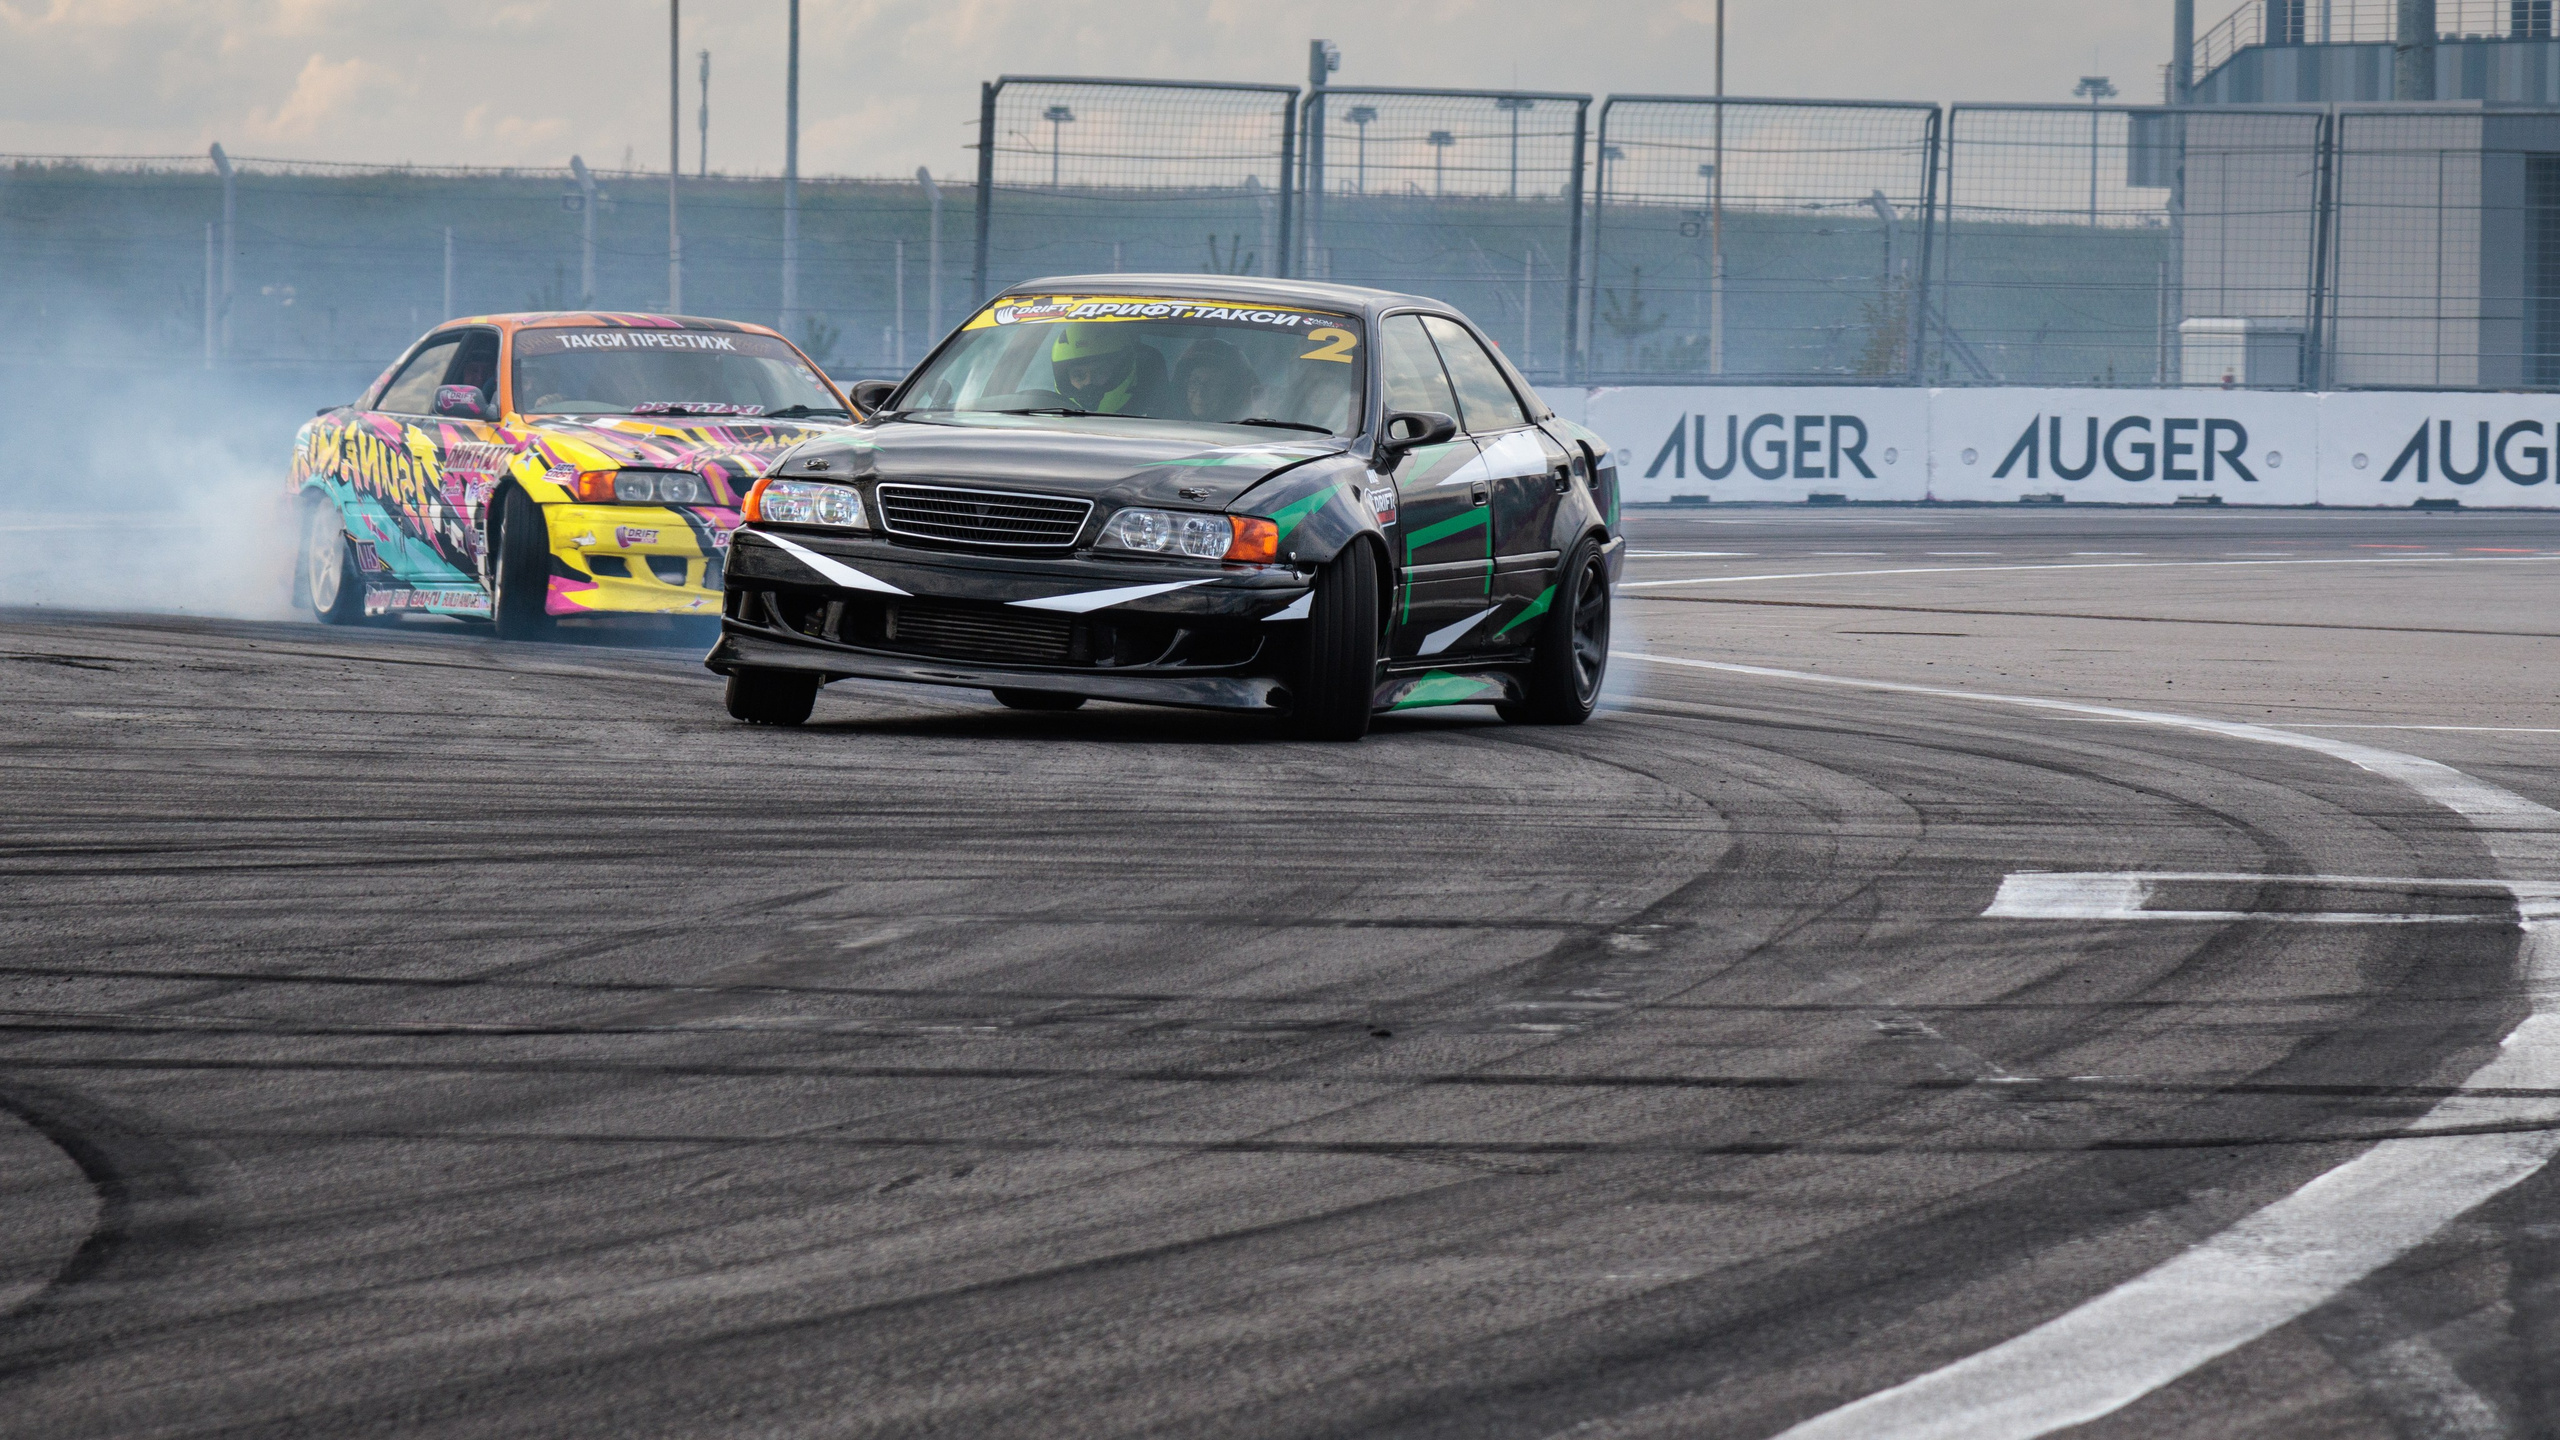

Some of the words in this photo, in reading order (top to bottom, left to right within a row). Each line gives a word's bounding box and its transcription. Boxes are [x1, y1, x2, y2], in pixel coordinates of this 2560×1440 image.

[1016, 304, 1073, 315] DRIFT
[1067, 303, 1193, 318] ДРИФТ
[1193, 306, 1302, 327] ТАКСИ
[555, 333, 627, 349] ТАКСИ
[628, 334, 737, 351] ПРЕСТИЖ
[1300, 328, 1357, 364] 2
[449, 392, 477, 400] DRIFT
[1644, 411, 1878, 480] AUGER
[1991, 413, 2259, 482] AUGER
[2380, 416, 2560, 486] AUG
[1373, 492, 1395, 512] DRIFT
[627, 529, 659, 538] DRIFT
